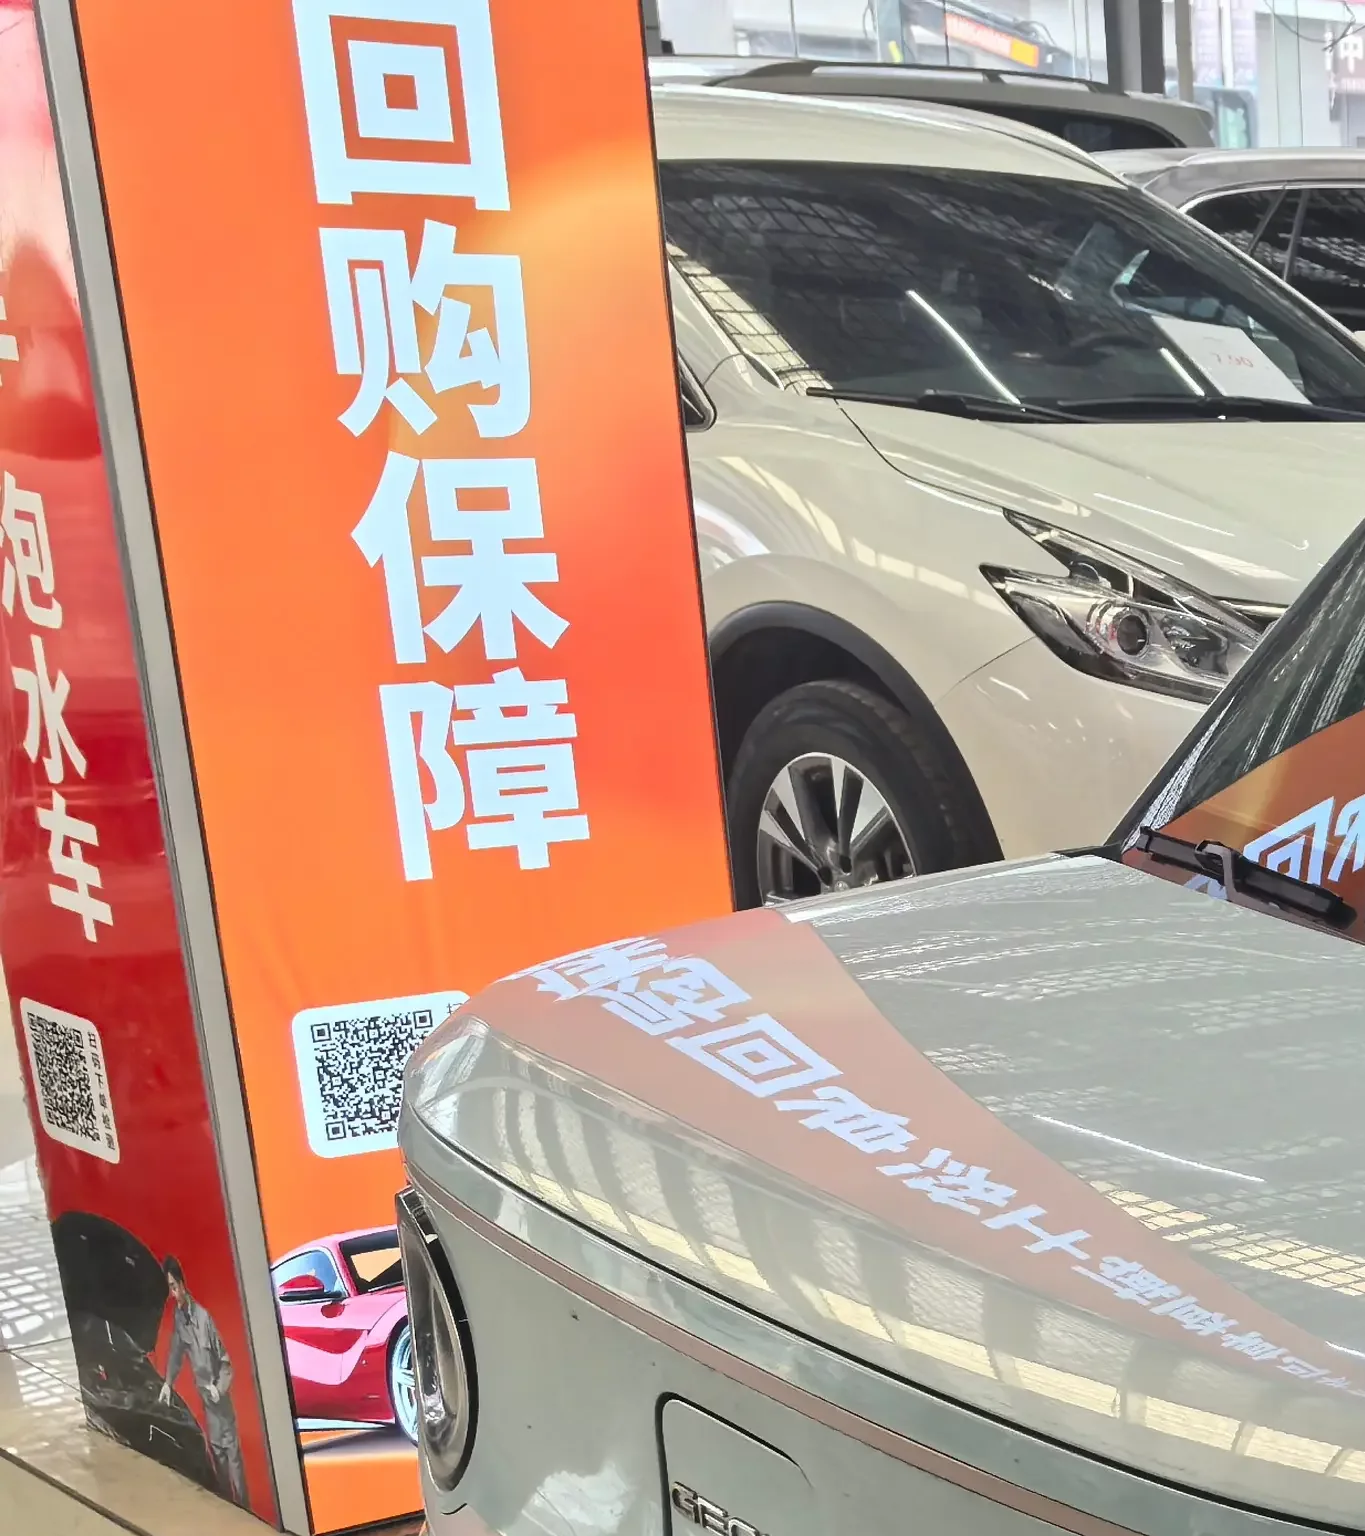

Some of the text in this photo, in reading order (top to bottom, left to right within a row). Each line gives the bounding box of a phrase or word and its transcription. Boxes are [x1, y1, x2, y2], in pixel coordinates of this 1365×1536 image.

[0, 469, 114, 943] 泡水车
[292, 0, 590, 881] 回购保障
